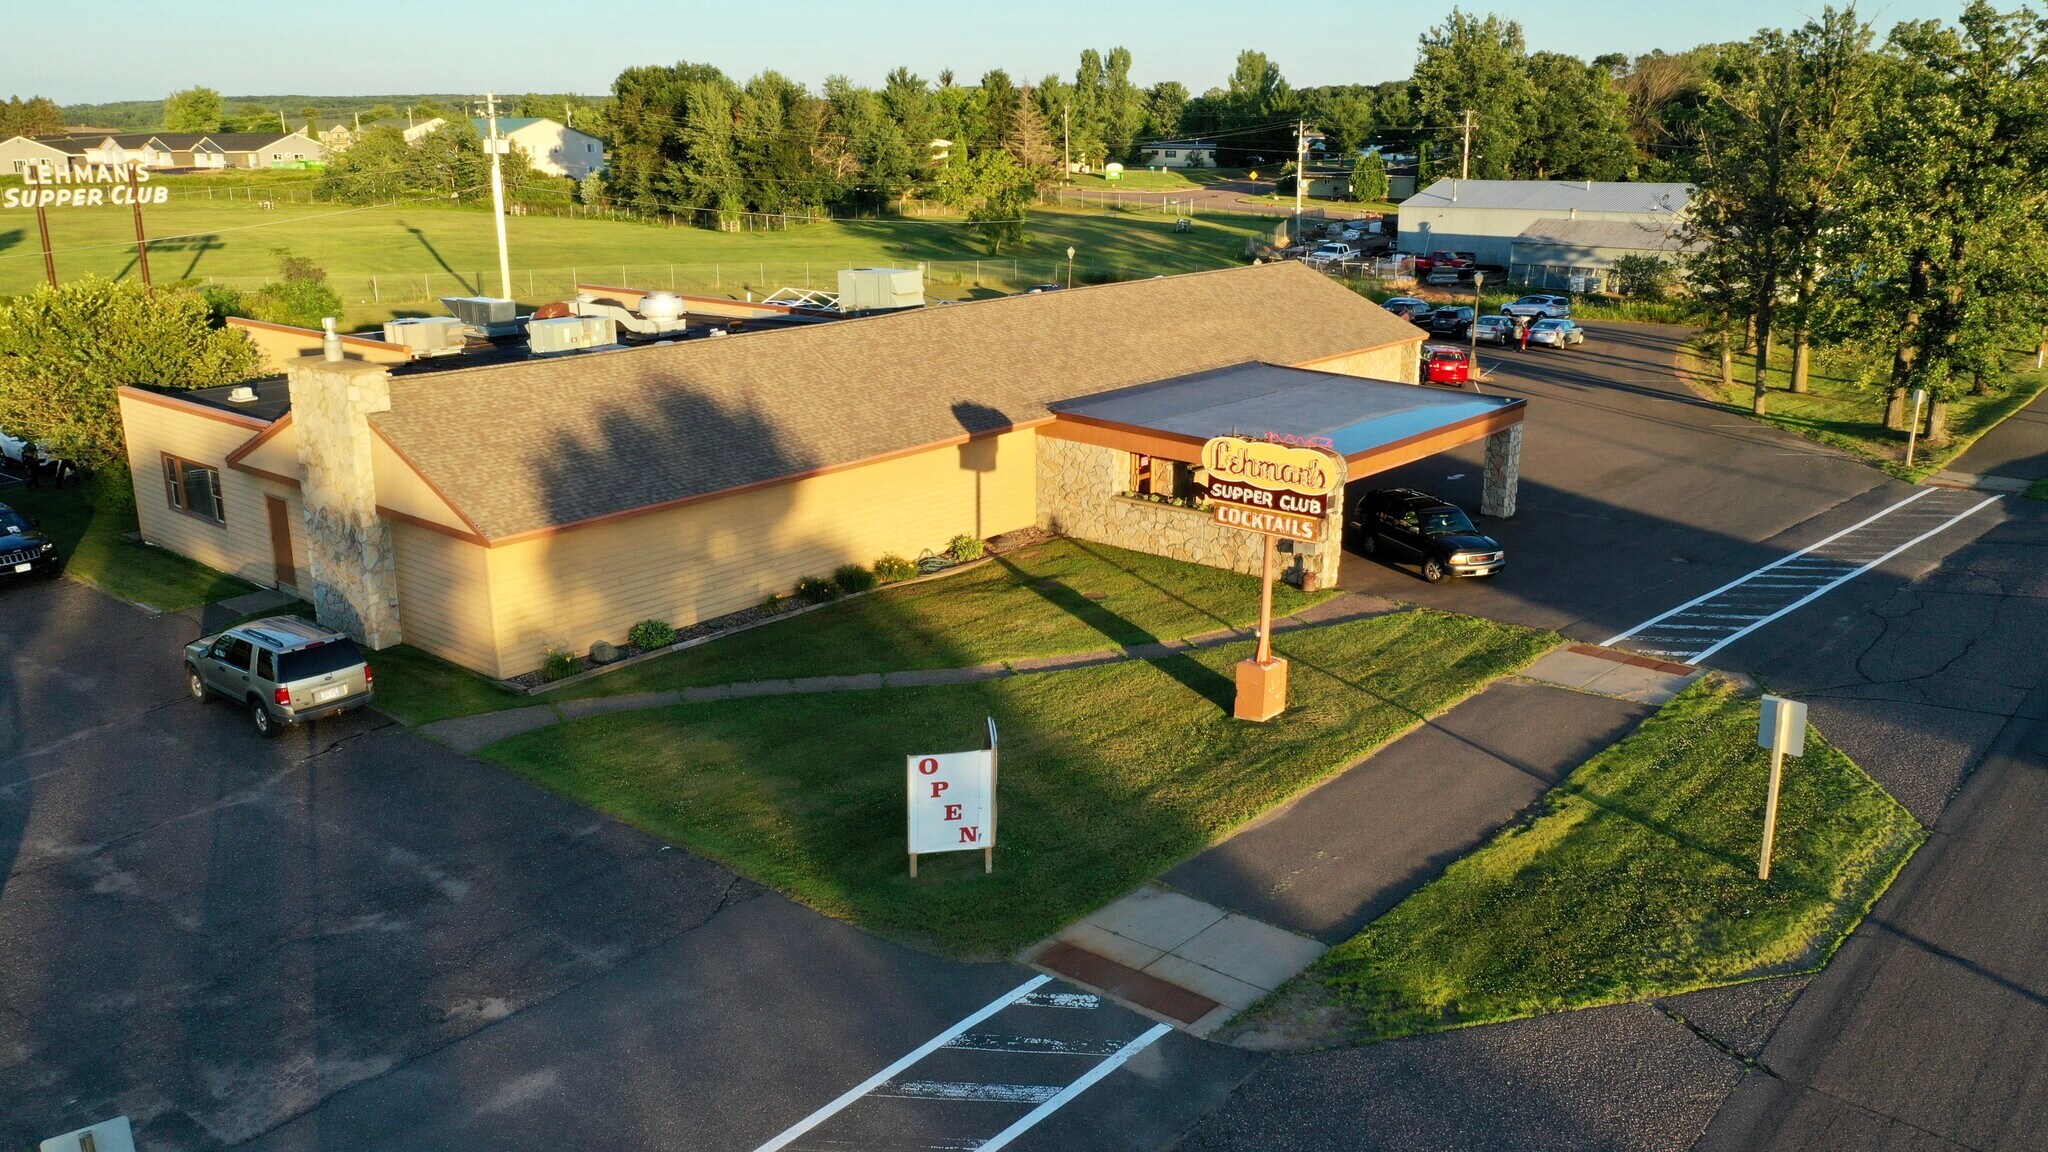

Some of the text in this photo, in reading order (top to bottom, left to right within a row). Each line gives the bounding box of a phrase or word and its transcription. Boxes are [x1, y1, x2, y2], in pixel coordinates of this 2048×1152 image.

[22, 163, 150, 185] LEHMAN'S
[3, 185, 169, 208] SUPPER CLUB
[1210, 440, 1327, 489] Lehman's
[1210, 483, 1322, 515] SUPPER CLUB
[1217, 506, 1314, 539] COCKTAILS
[918, 757, 979, 844] OPEN
